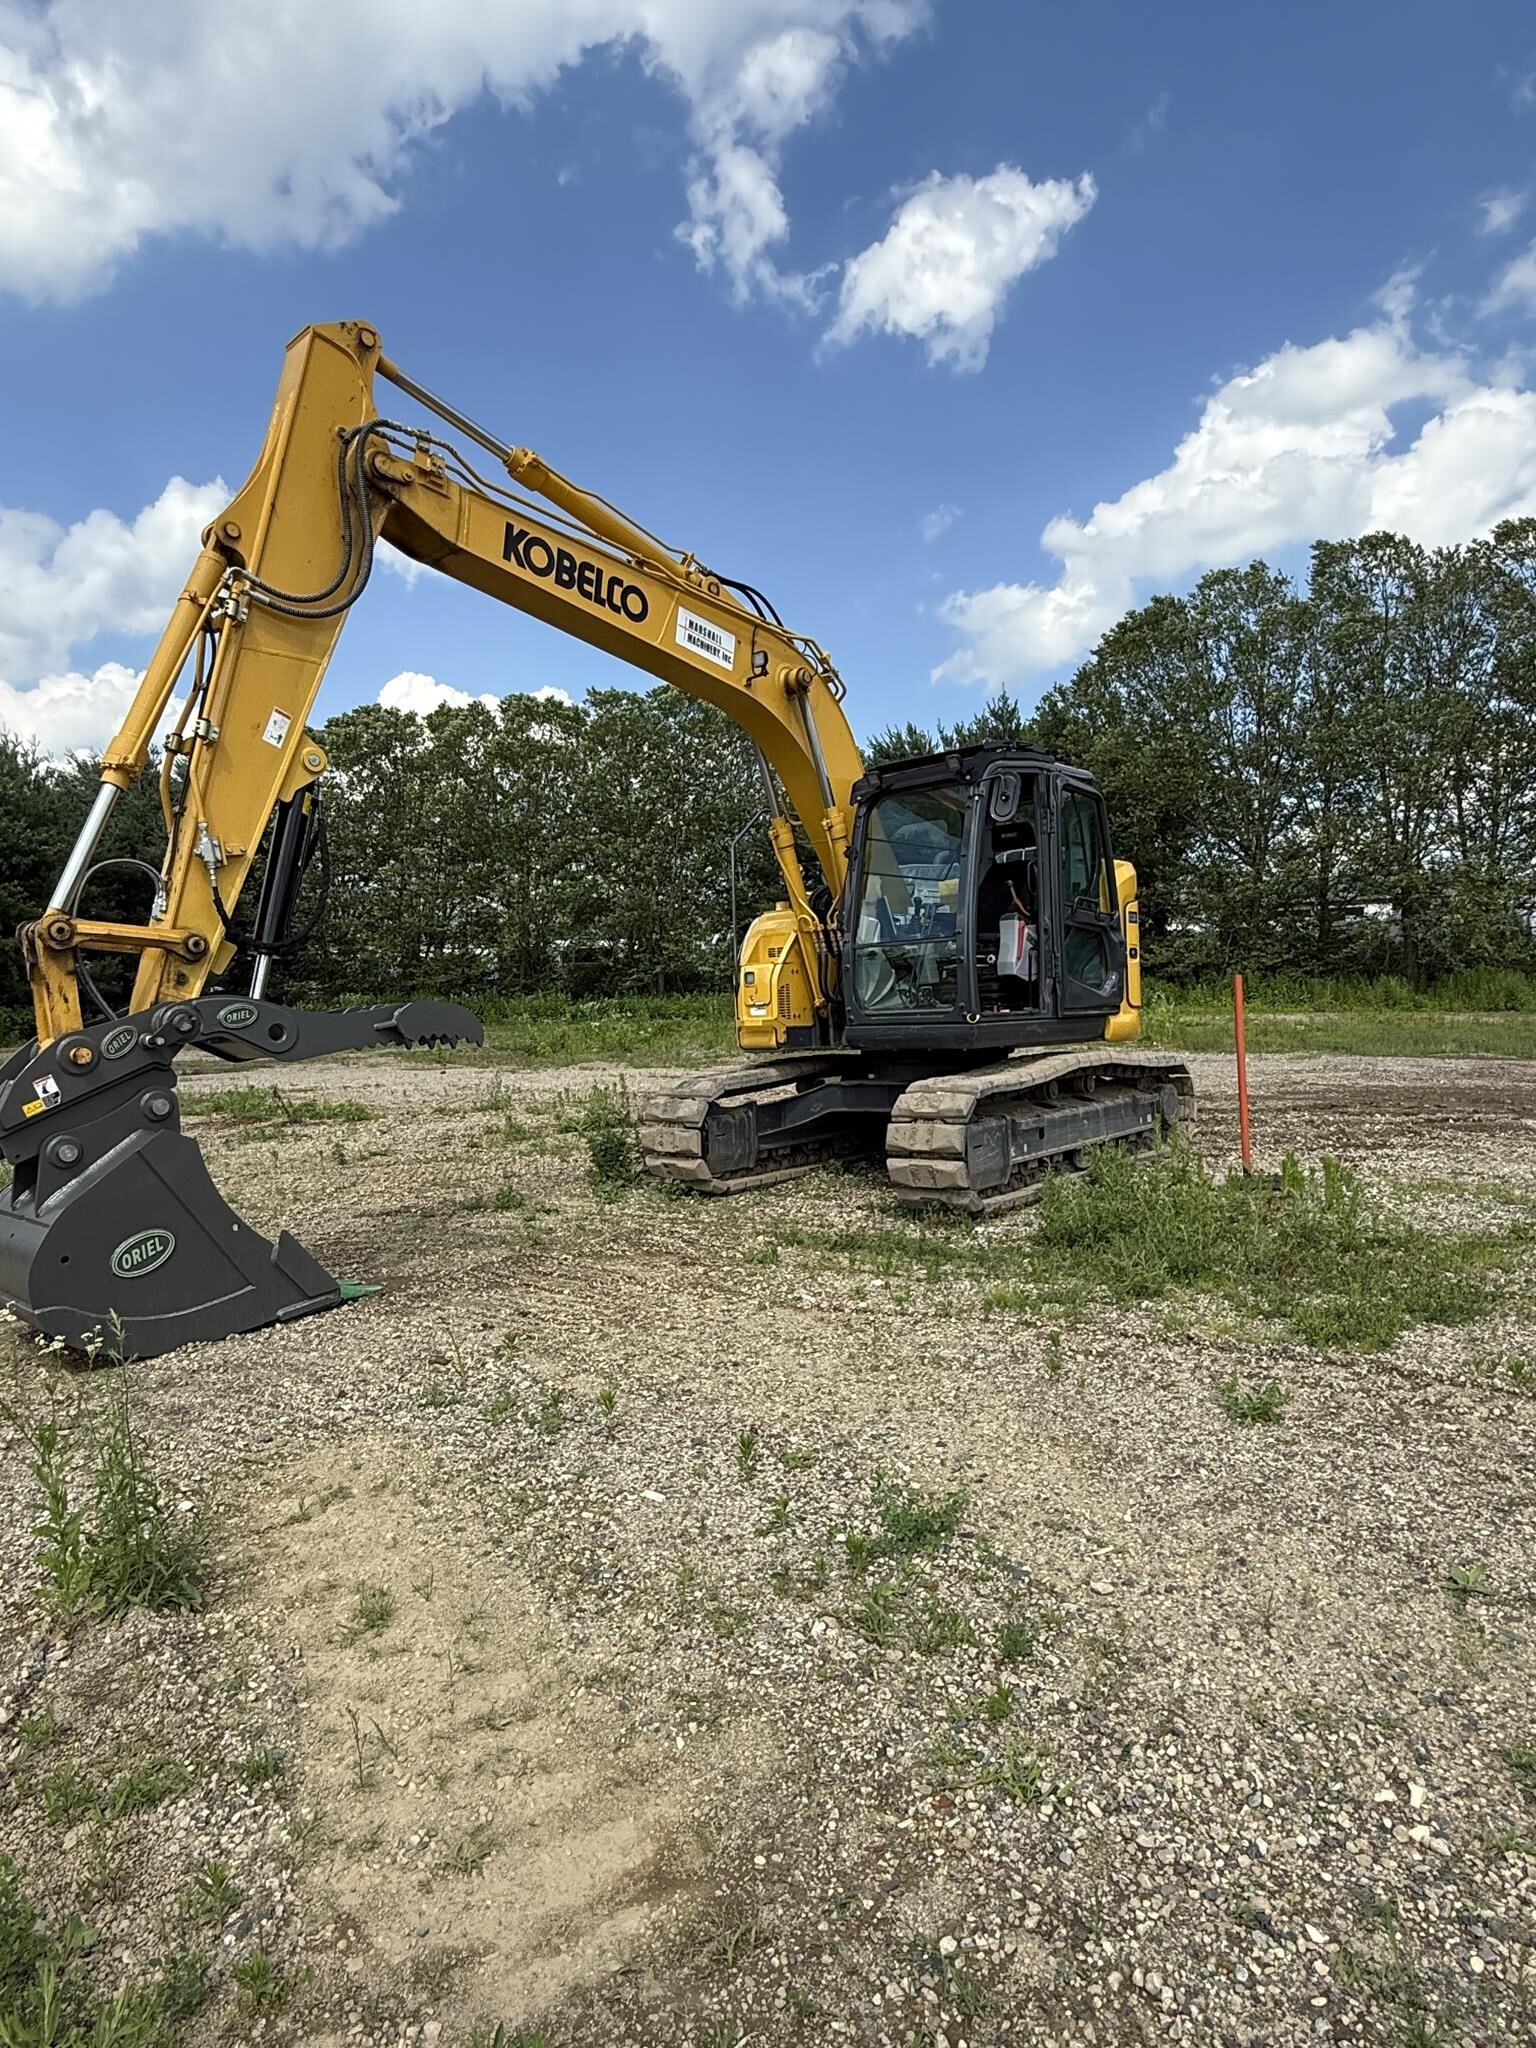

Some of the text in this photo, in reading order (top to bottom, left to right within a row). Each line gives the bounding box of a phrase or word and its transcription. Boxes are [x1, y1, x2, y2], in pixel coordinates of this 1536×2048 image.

[502, 521, 649, 623] KOBELCO
[688, 619, 722, 645] MARSHALL
[226, 1009, 251, 1023] ORIEL
[108, 1032, 132, 1054] ORIEL
[122, 1236, 164, 1270] ORIEL
